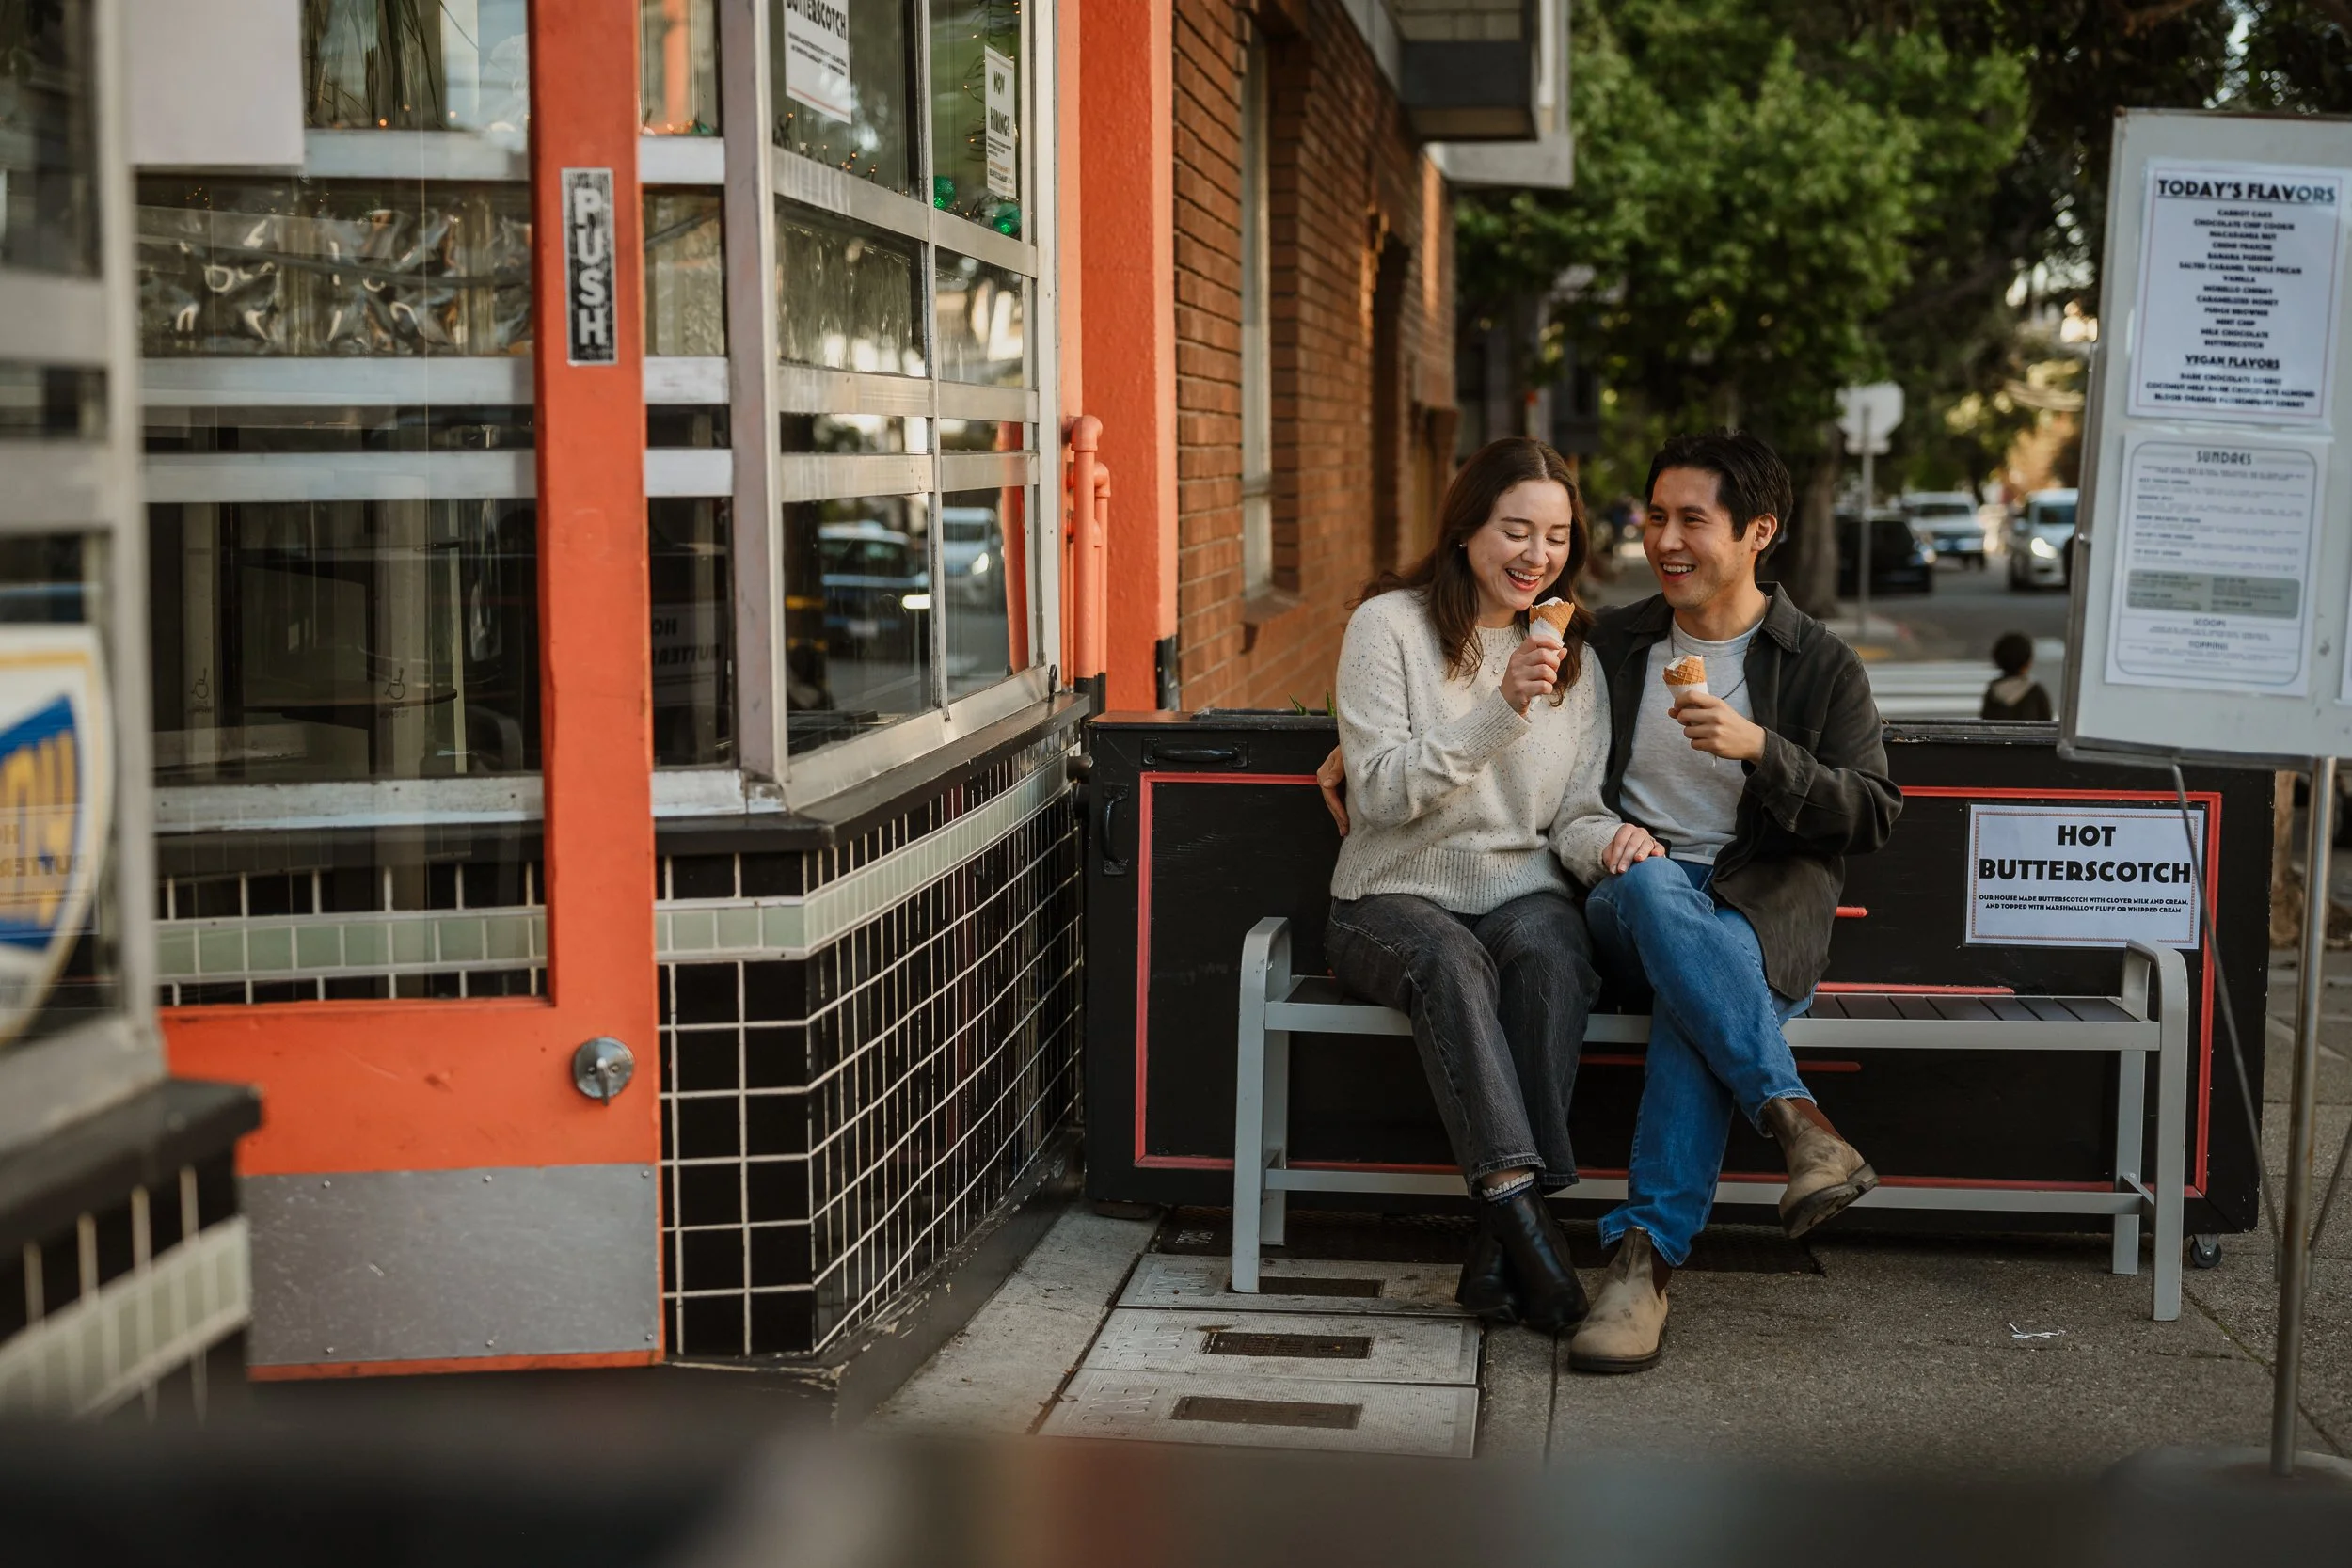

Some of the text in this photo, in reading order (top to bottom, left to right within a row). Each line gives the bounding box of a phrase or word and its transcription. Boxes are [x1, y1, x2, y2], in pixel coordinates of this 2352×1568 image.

[2158, 179, 2335, 203] TODAY'S FLAVORS
[2194, 218, 2240, 228] CHOCOLATE
[574, 187, 607, 345] PUSH
[2185, 355, 2280, 370] VEGAN FLAVORS
[2058, 825, 2116, 847] HOT
[1979, 858, 2191, 884] BUTTERSCOTCH
